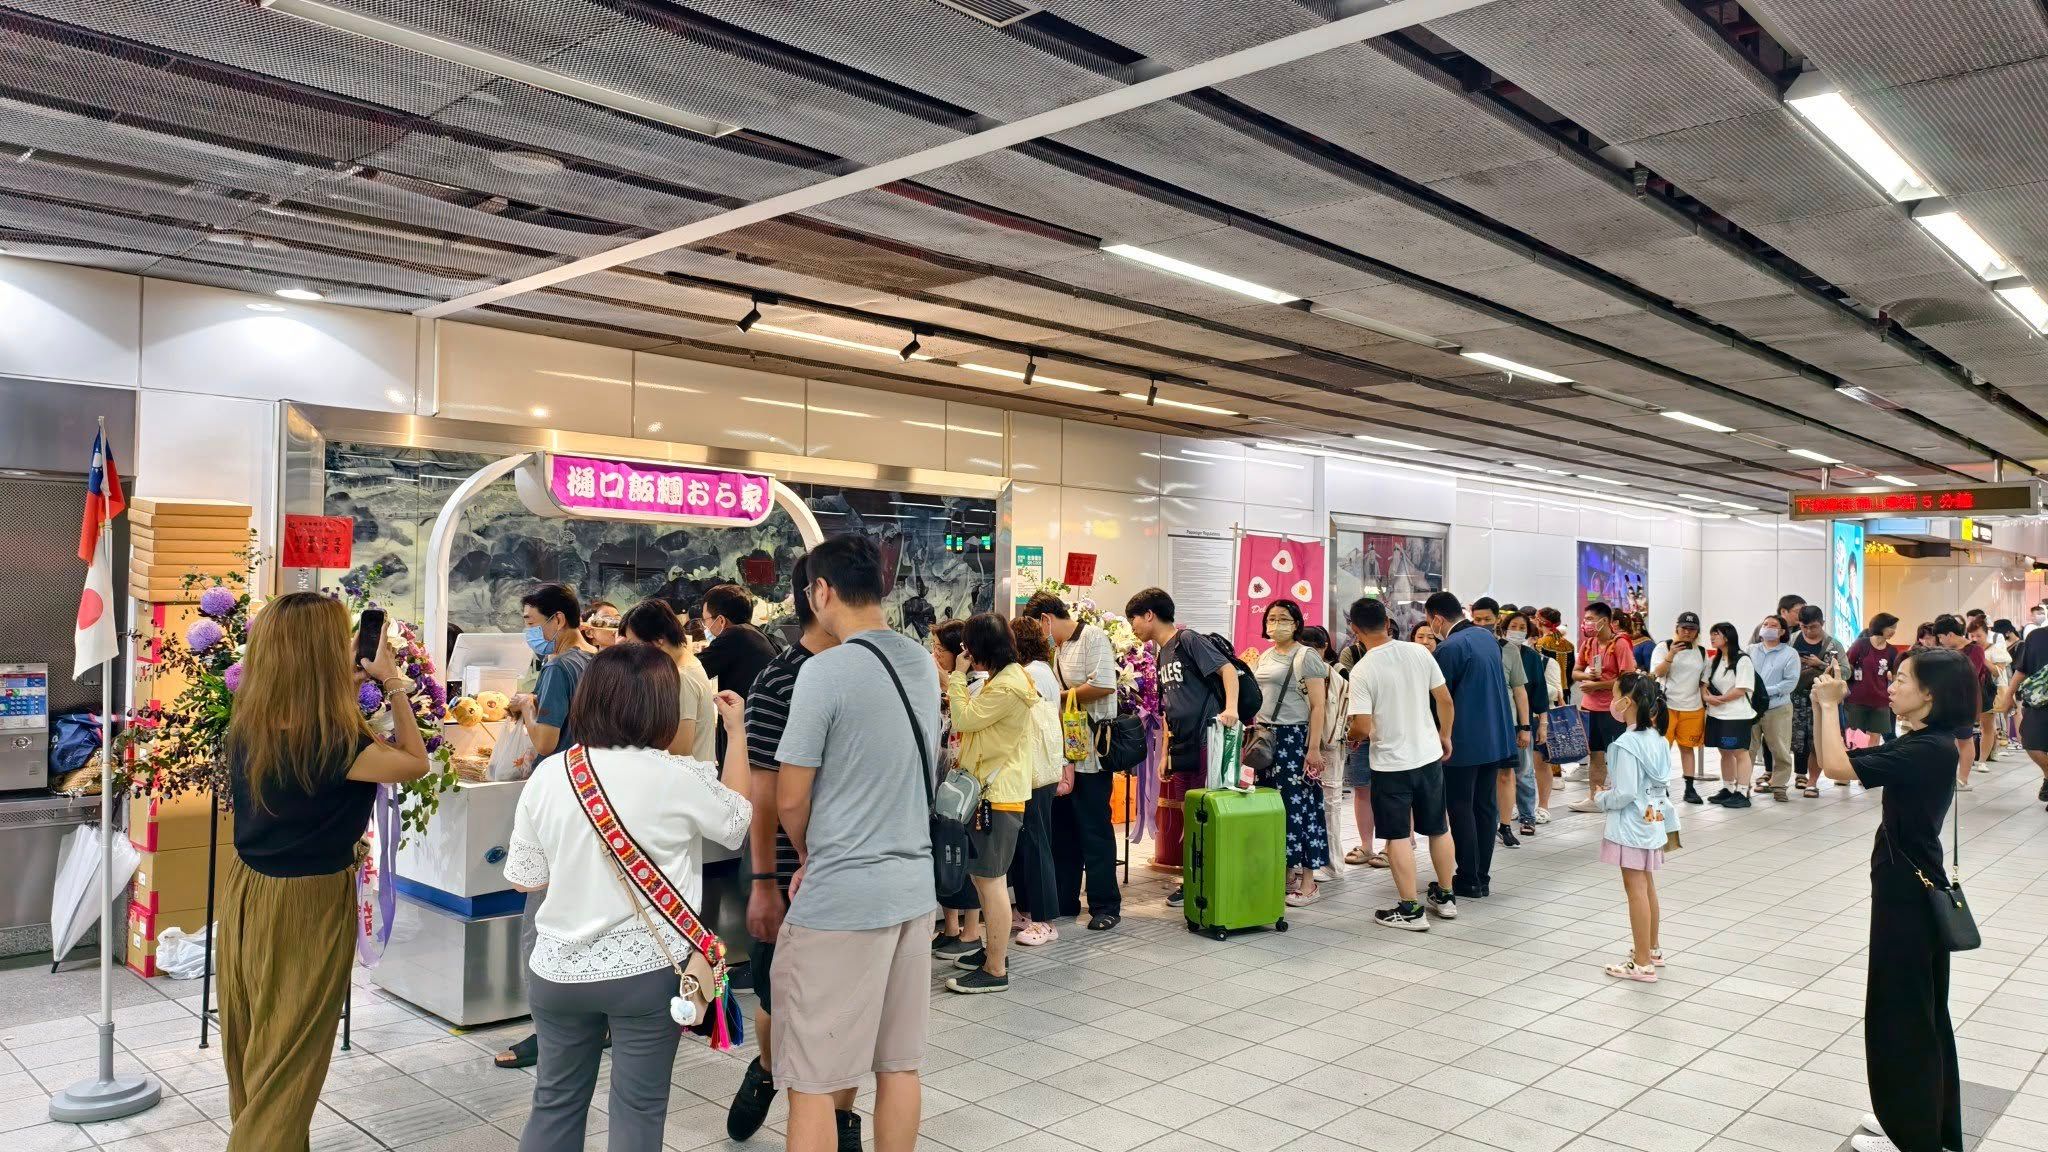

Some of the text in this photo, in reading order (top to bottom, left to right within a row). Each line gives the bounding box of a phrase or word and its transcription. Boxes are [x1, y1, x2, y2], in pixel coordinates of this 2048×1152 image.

[566, 465, 763, 513] 樋口飯糰おら家
